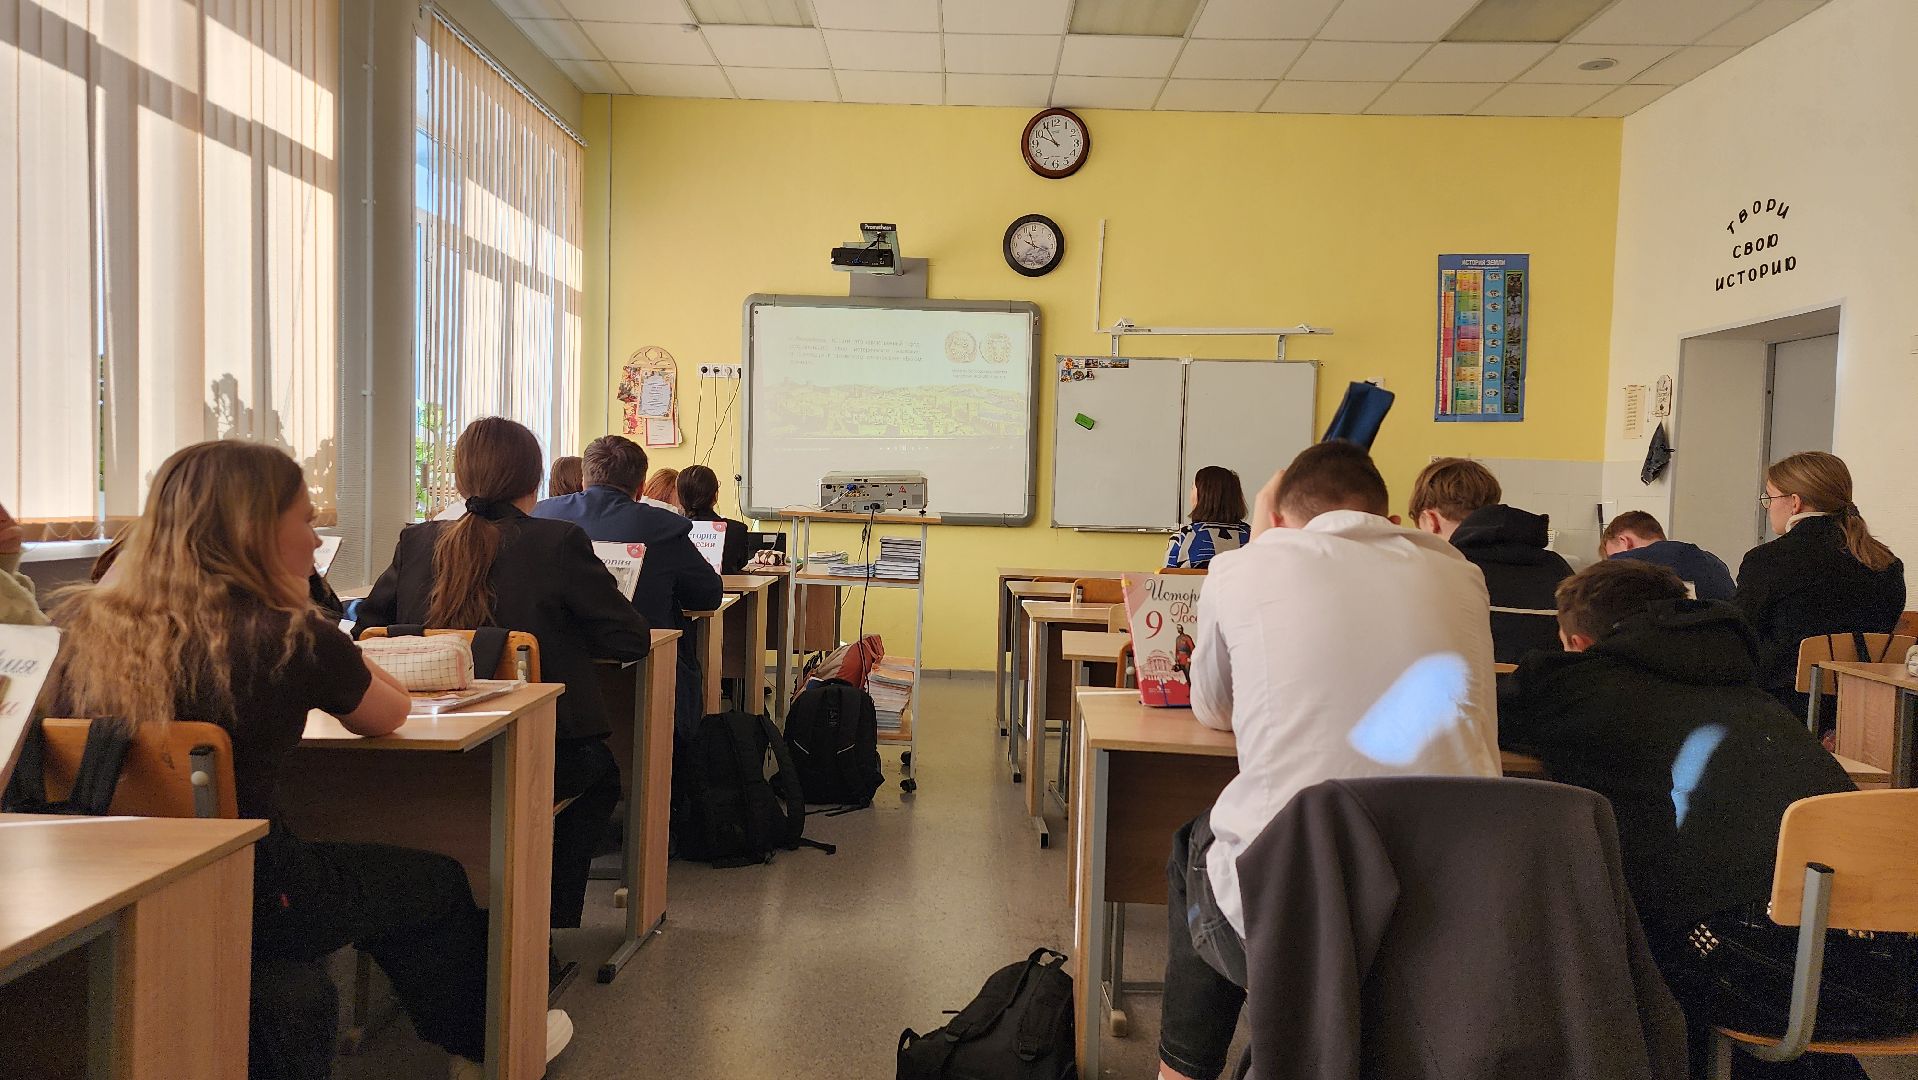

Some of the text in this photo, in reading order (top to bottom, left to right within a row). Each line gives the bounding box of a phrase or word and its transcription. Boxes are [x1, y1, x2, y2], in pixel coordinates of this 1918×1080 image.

[1051, 119, 1060, 127] 12
[1065, 121, 1068, 129] 1
[1035, 130, 1043, 138] 10
[1070, 129, 1076, 137] 2
[1032, 140, 1039, 148] 9
[1074, 139, 1079, 147] 3
[1052, 160, 1059, 168] 6
[1726, 198, 1790, 234] ТВОРИ
[1732, 233, 1779, 258] СВОЮ
[1715, 256, 1797, 291] ИСТОРИЮ
[1145, 610, 1163, 639] 9
